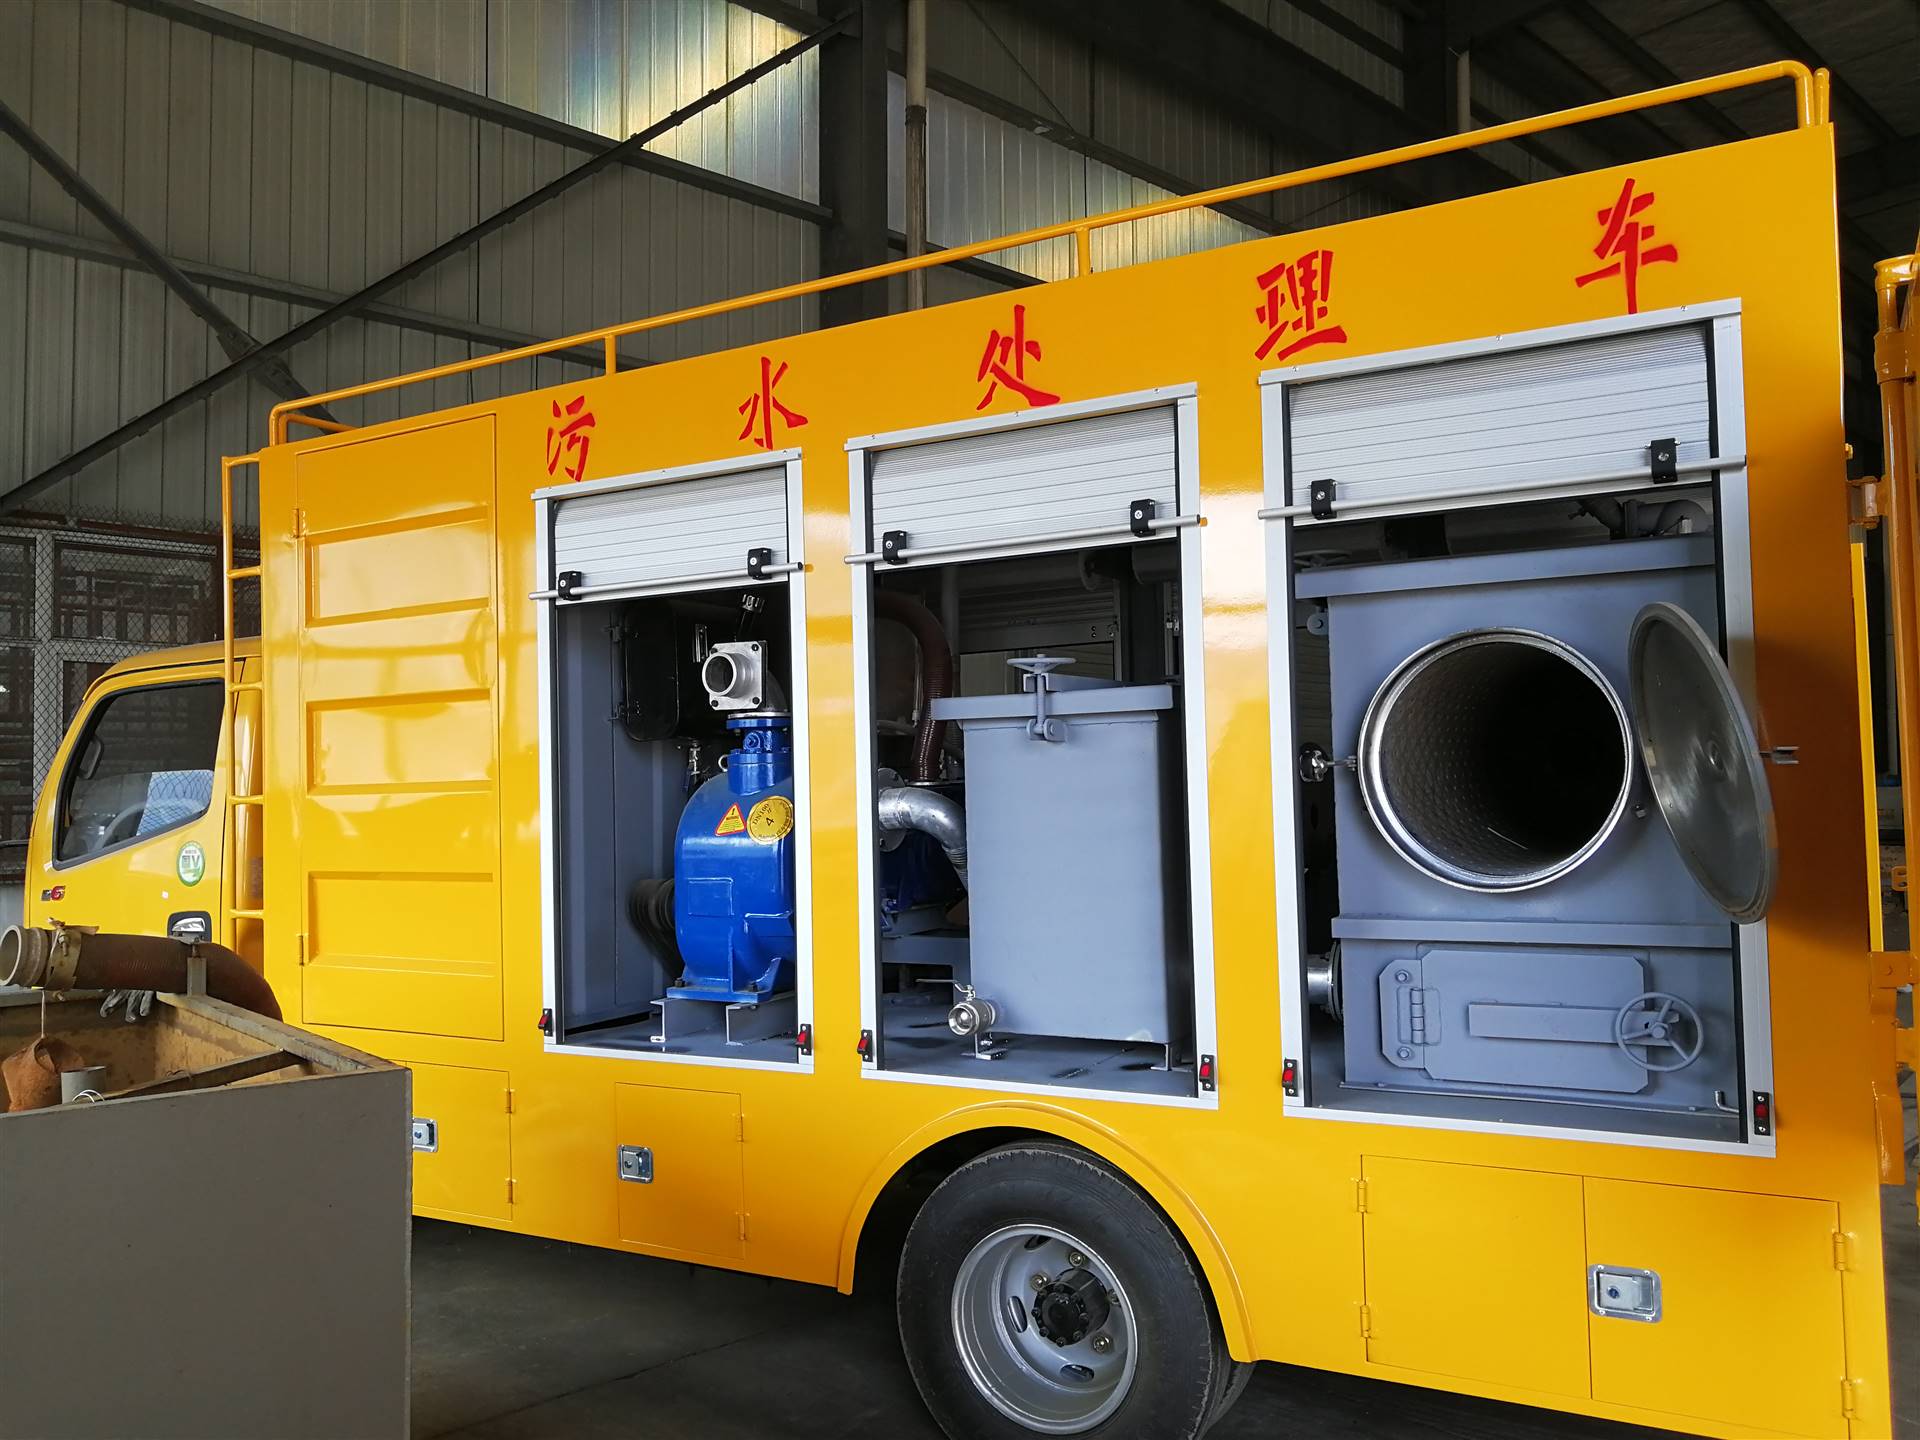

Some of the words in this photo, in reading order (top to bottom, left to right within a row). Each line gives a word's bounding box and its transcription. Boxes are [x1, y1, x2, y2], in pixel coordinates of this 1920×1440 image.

[547, 178, 1678, 482] 污水处理车
